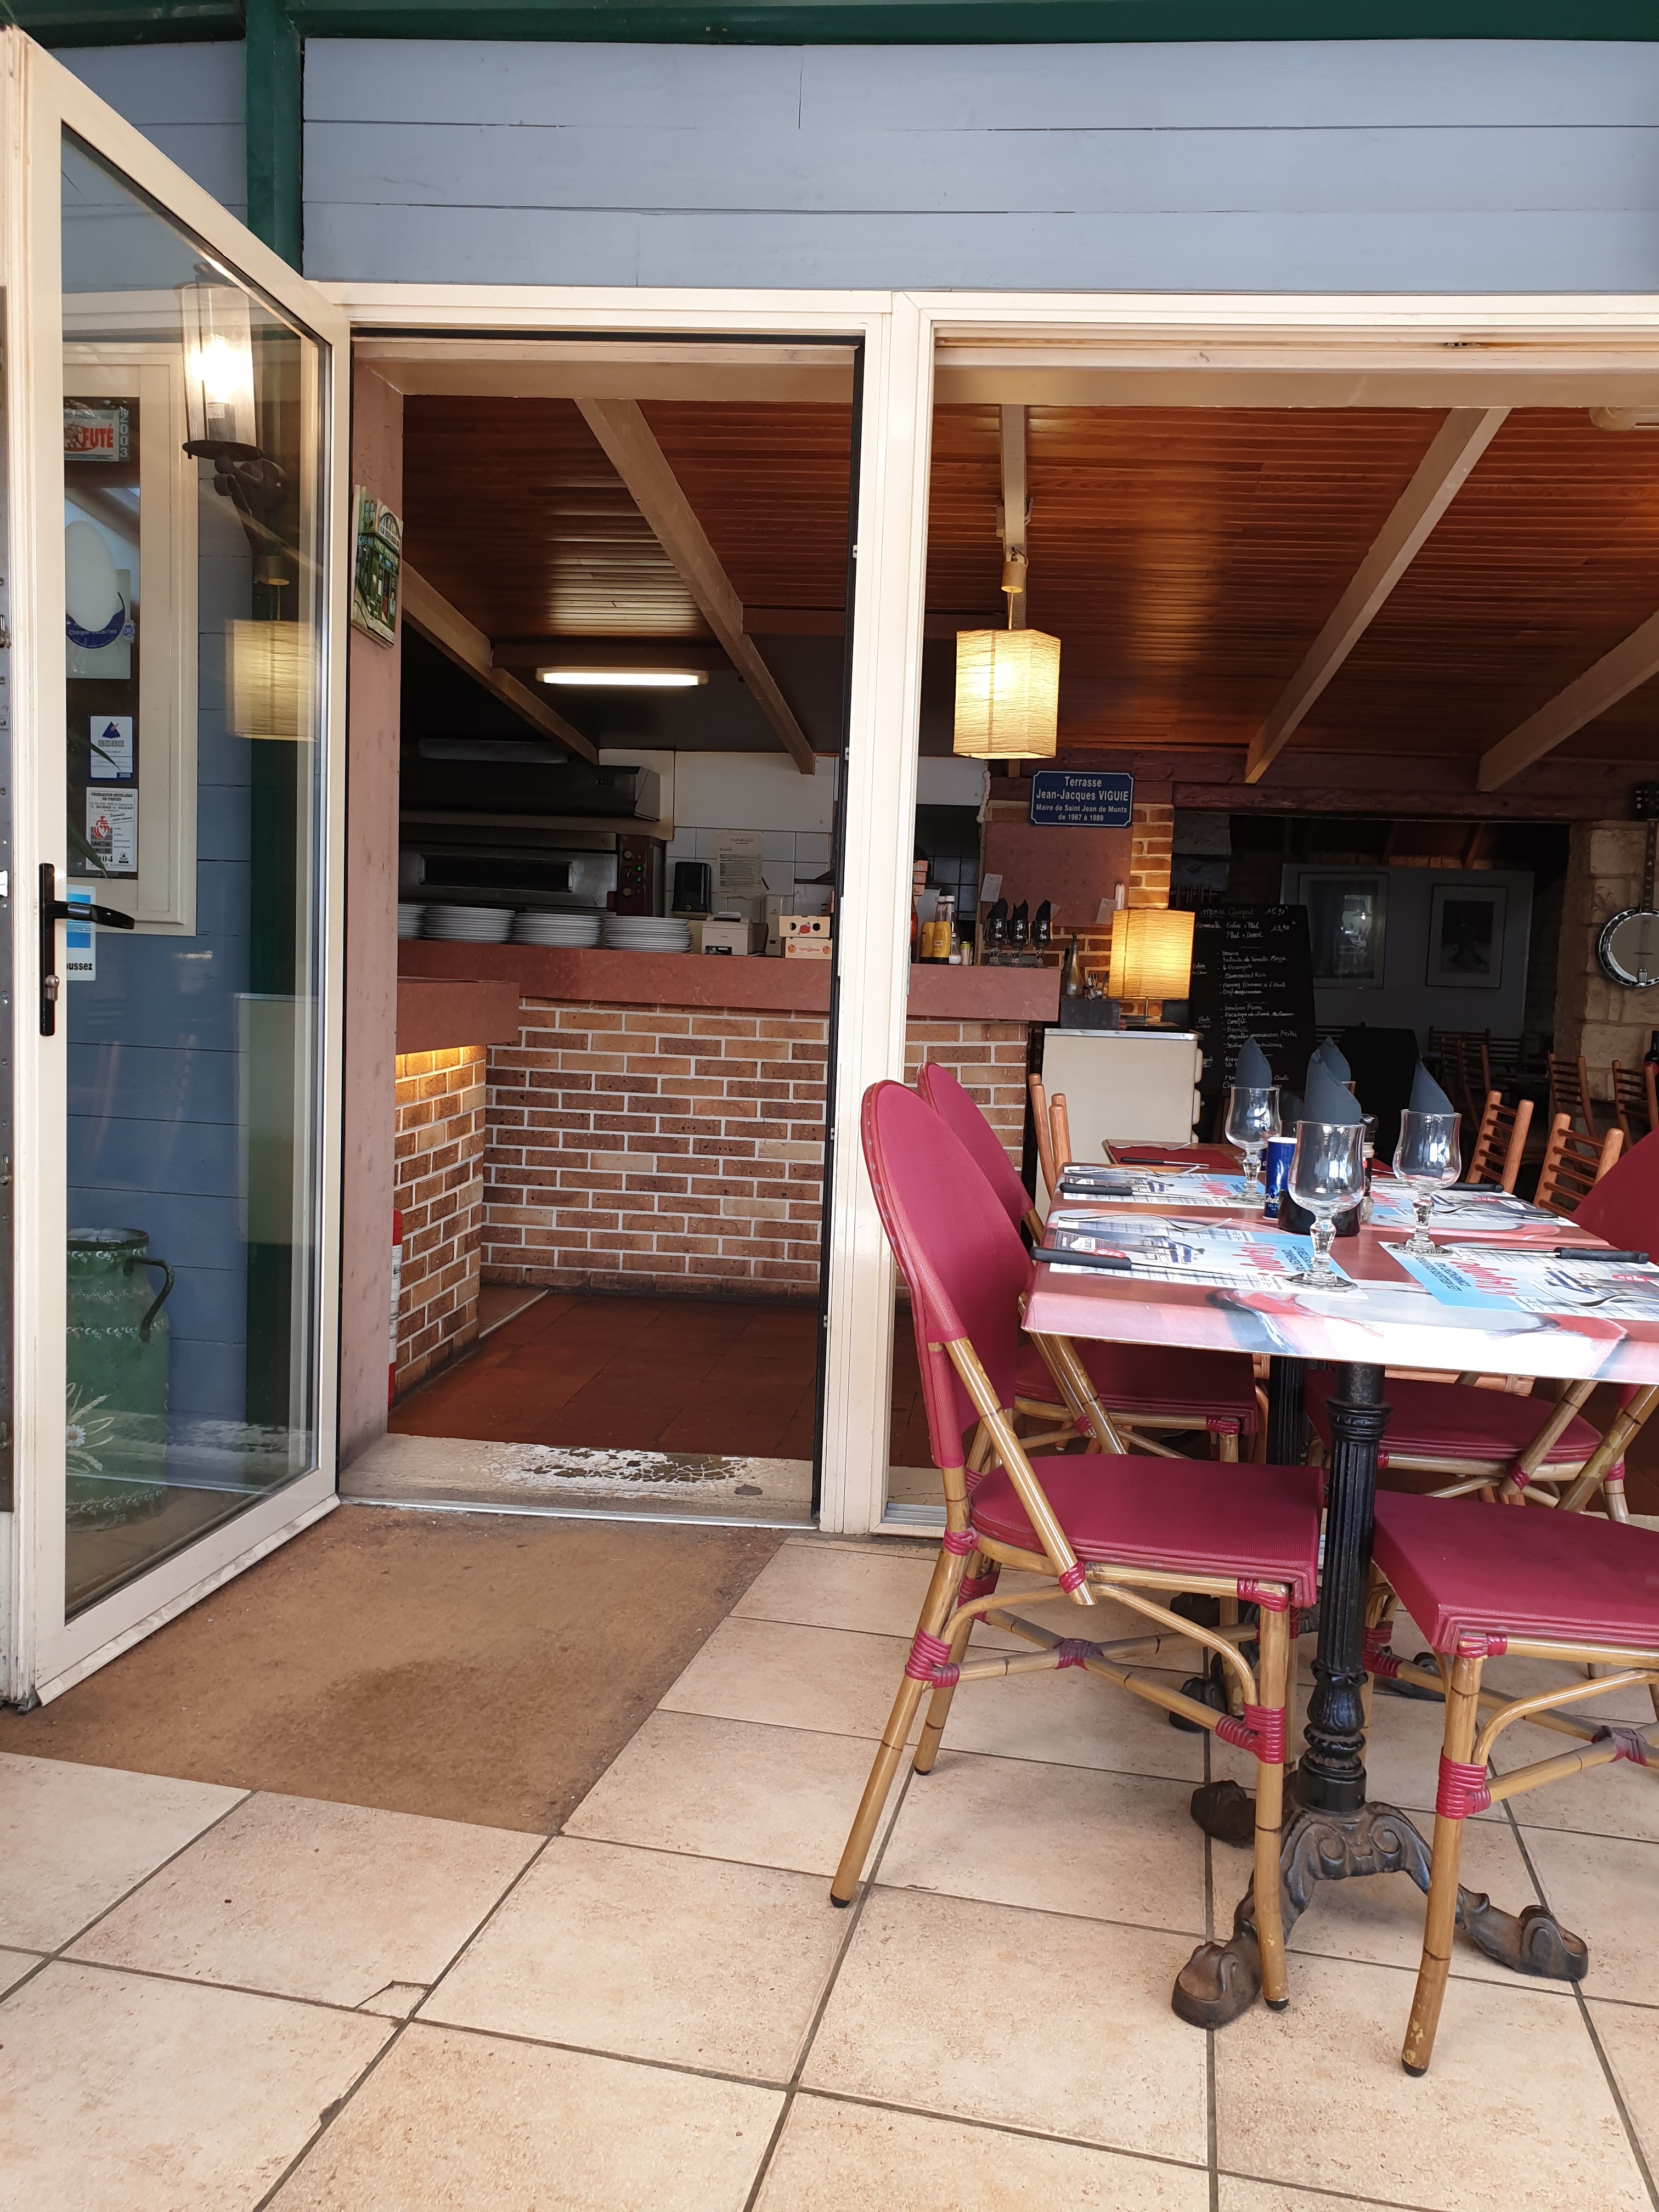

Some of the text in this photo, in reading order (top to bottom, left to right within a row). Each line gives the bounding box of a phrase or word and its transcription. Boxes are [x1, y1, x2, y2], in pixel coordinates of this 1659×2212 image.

[82, 423, 114, 448] FUTÉ
[1064, 776, 1102, 788] Terrasse
[1036, 789, 1129, 802] Jean-Jacques VIGUIE
